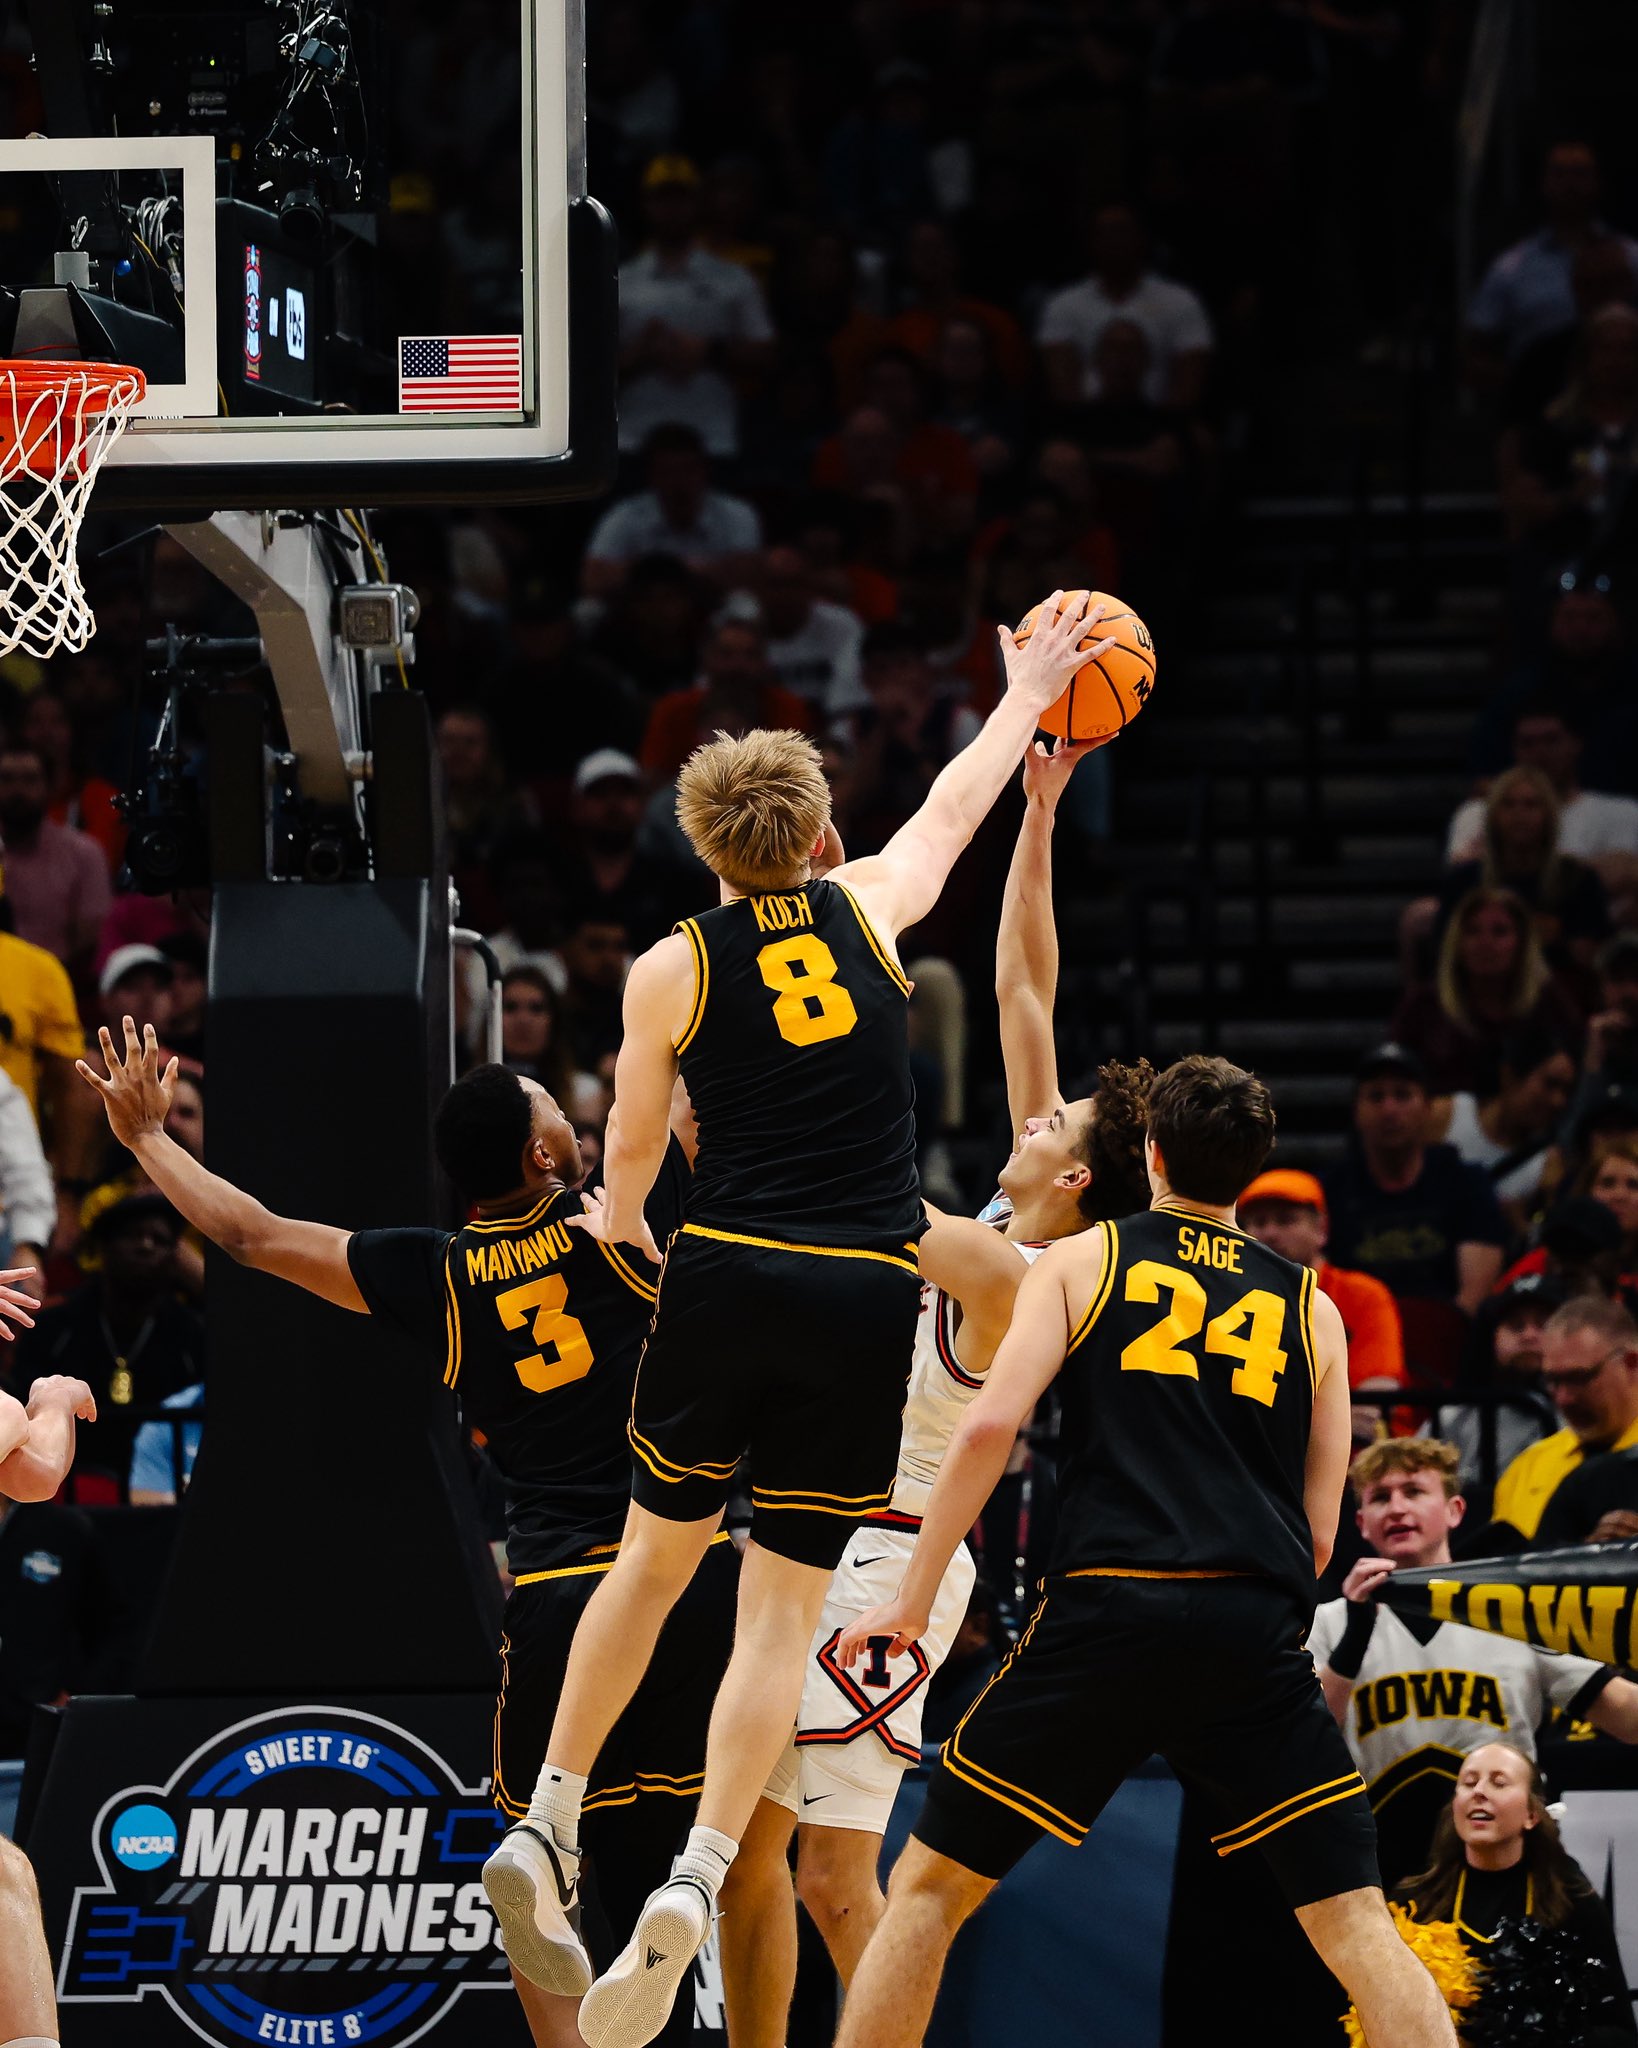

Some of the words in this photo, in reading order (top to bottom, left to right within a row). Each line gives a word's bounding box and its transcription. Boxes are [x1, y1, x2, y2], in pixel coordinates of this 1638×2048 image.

[750, 892, 814, 932] KOCH
[756, 933, 858, 1047] 8
[465, 1219, 573, 1286] MANYAWU
[1177, 1226, 1245, 1275] SAGE
[495, 1272, 595, 1393] 3
[1120, 1259, 1288, 1408] 24
[1427, 1578, 1638, 1672] IOW
[1351, 1668, 1509, 1741] IOWA
[245, 1736, 332, 1775] SWEET
[338, 1739, 373, 1769] 16
[117, 1836, 176, 1855] NCAA
[180, 1807, 428, 1877] MARCH
[208, 1883, 506, 1953] MADNES
[258, 2013, 334, 2045] ELITE
